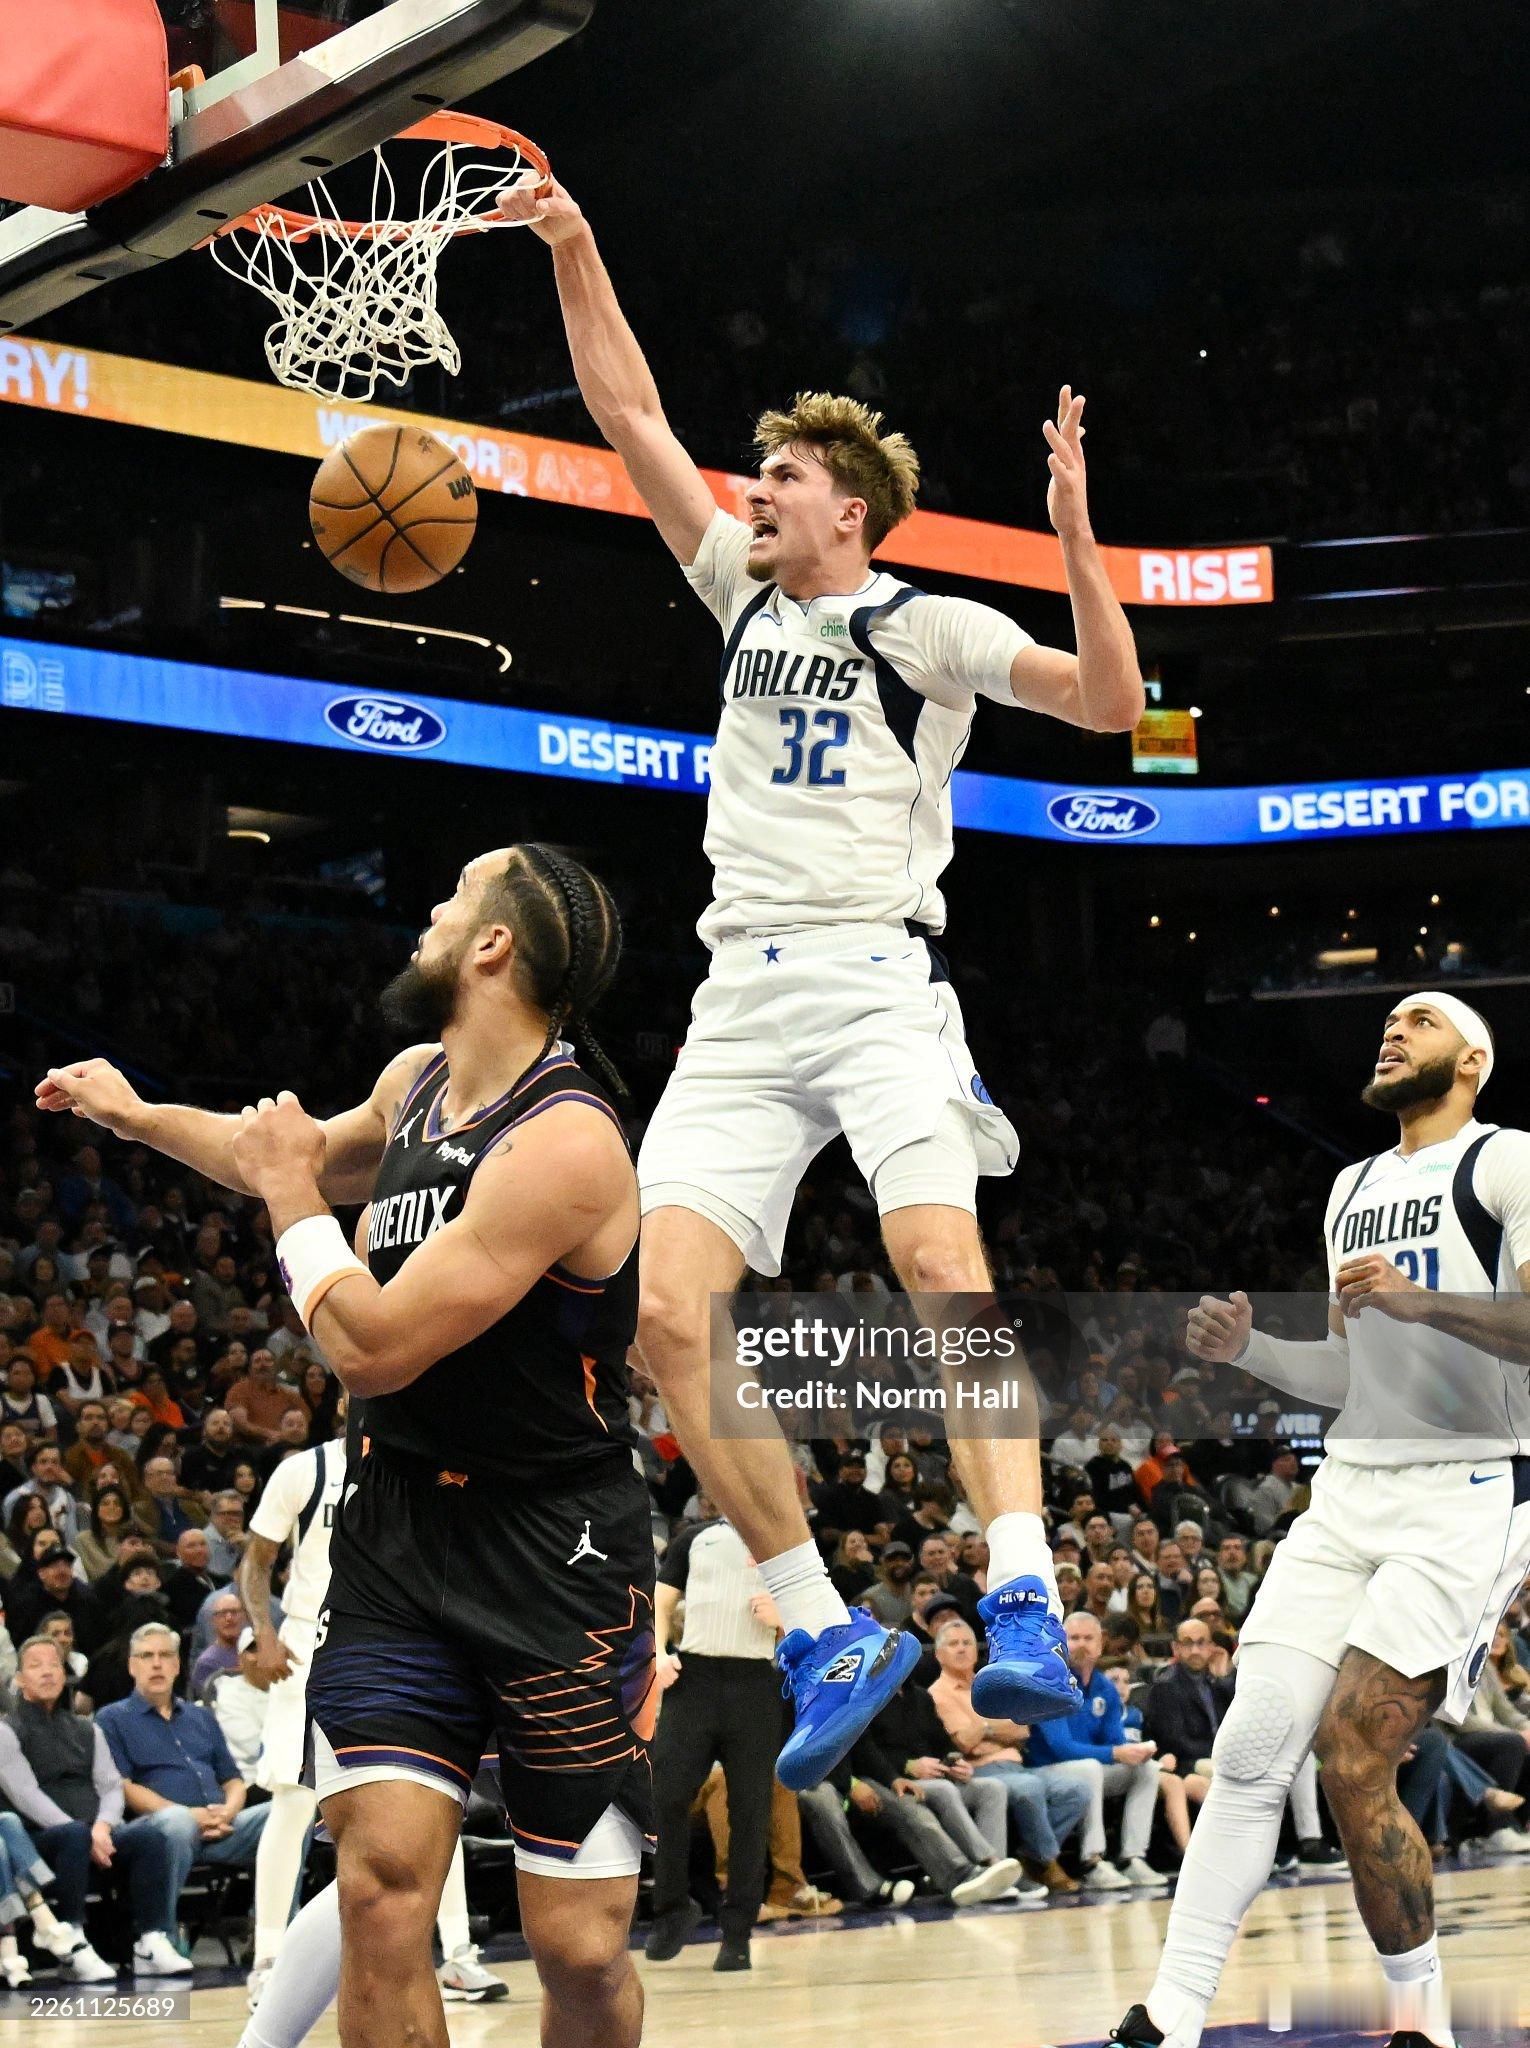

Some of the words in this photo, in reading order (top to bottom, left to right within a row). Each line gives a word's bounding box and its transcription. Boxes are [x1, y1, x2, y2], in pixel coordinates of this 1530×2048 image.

[1138, 551, 1262, 601] RISE
[732, 649, 865, 702] DALLAS
[346, 697, 422, 745] Ford
[538, 723, 685, 781] DESERT
[770, 707, 850, 787] 32
[1064, 796, 1137, 832] Ford
[1258, 785, 1429, 833] DESERT
[436, 1140, 476, 1167] PayPal
[368, 1185, 457, 1252] HOENIX
[1342, 1193, 1444, 1255] DALLAS
